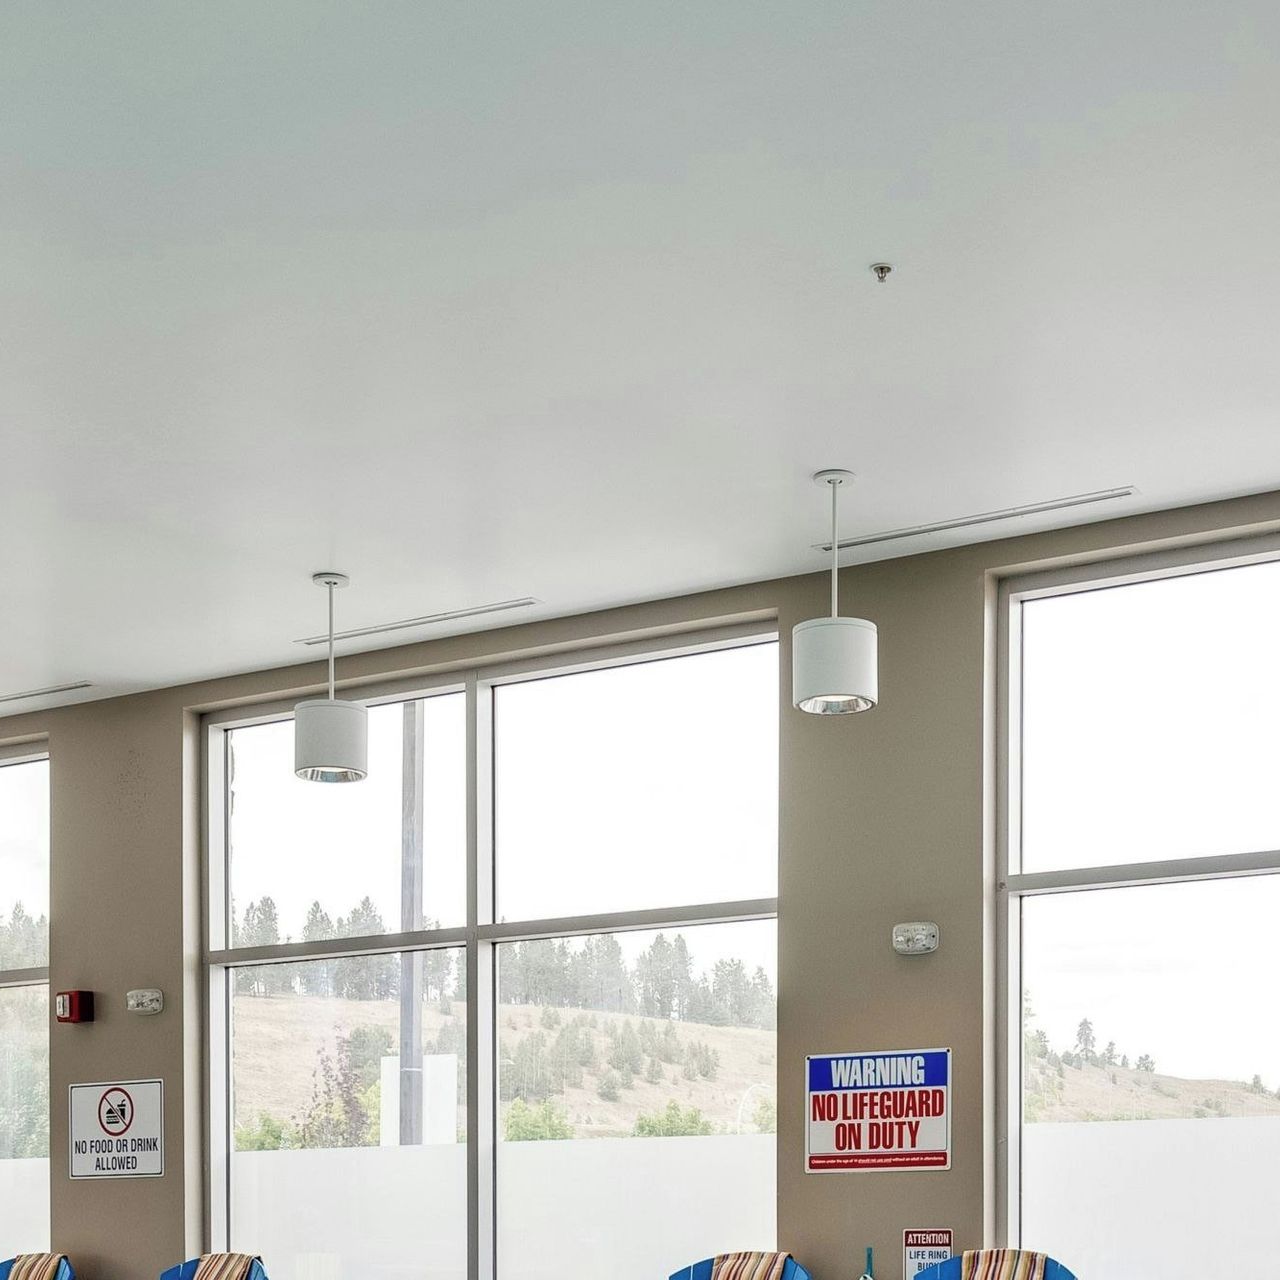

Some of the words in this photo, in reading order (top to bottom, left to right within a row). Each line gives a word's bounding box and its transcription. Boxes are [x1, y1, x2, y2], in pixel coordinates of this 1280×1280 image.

[831, 1056, 925, 1088] WARNING
[812, 1093, 838, 1121] NO
[842, 1089, 944, 1120] LIFEGUARD
[835, 1122, 861, 1151] ON
[869, 1121, 920, 1149] DUTY
[75, 1140, 87, 1154] NO
[90, 1139, 113, 1154] FOOD
[116, 1138, 128, 1153] OR
[131, 1137, 158, 1152] DRINK
[95, 1156, 137, 1171] ALLOWED
[907, 1233, 949, 1244] ATTENTION
[909, 1250, 926, 1260] LIFE
[928, 1250, 948, 1260] RING
